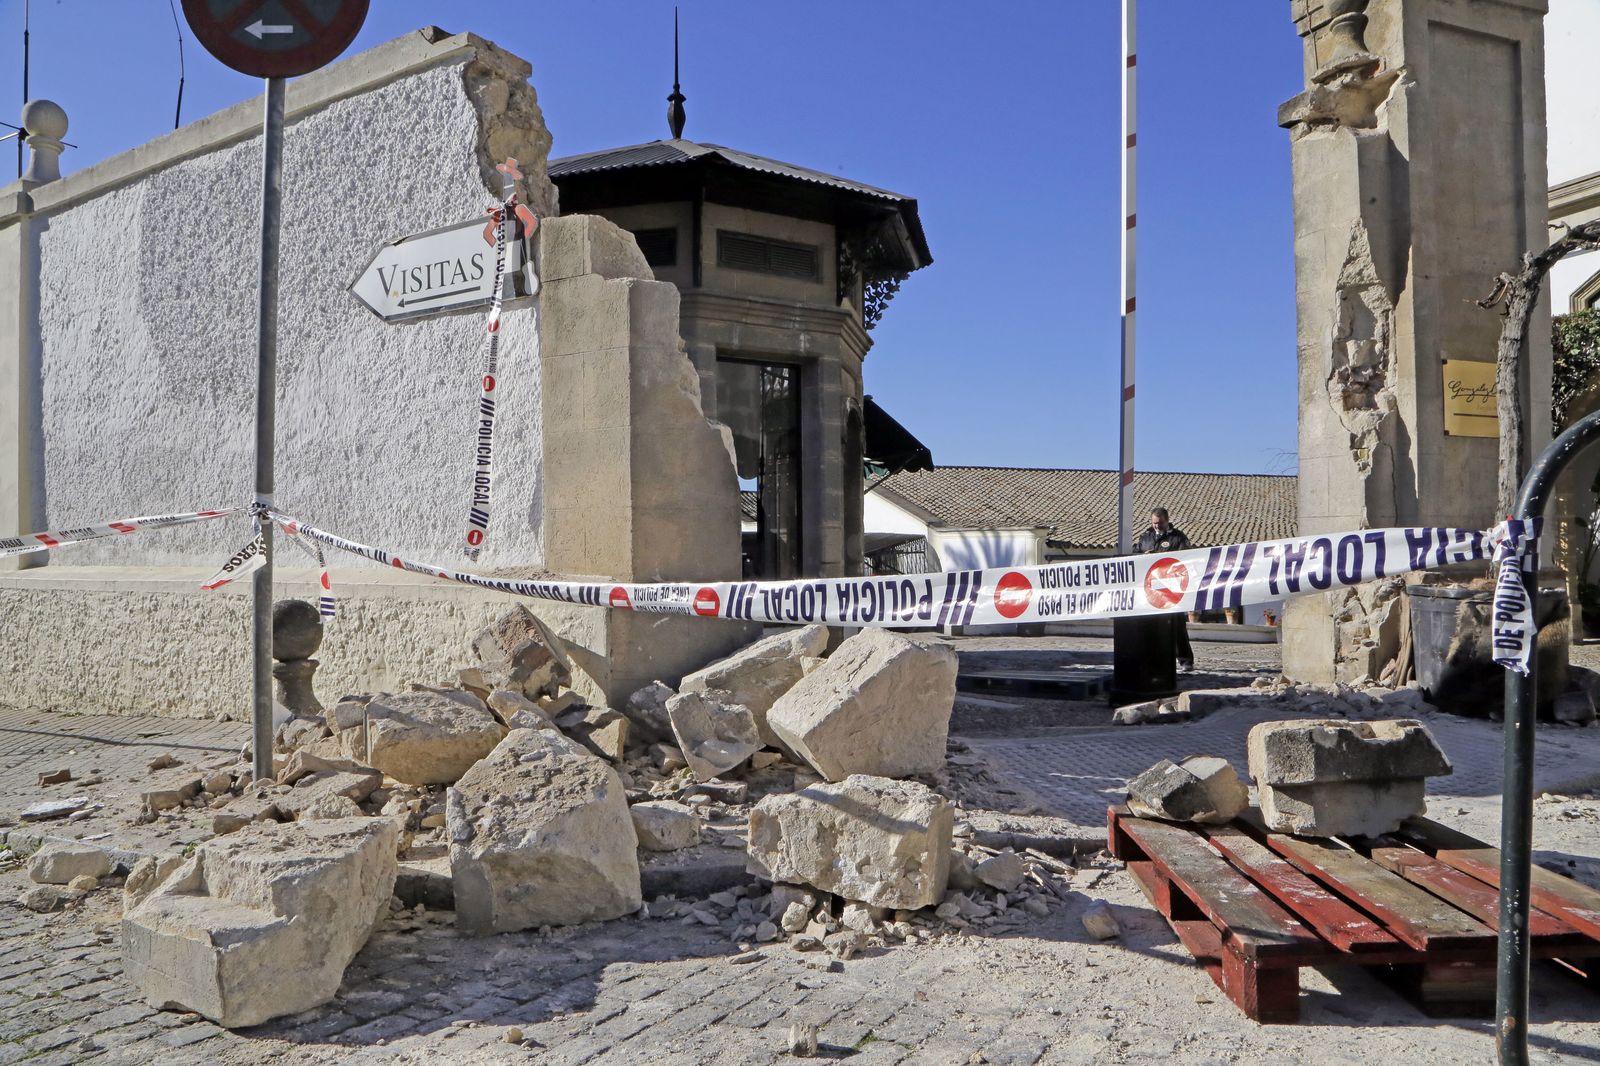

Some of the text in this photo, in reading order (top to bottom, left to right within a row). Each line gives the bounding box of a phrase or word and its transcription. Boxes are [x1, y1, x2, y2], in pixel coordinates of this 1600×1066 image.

[376, 253, 484, 298] VISITAS
[474, 419, 493, 506] POLICIA LOCAL
[1038, 560, 1136, 589] LINEA DE POLICIA
[1264, 532, 1386, 595] LOCAL
[759, 578, 933, 622] POLICIA LOCAL
[1038, 590, 1135, 616] PROIDO EL PASO
[1493, 628, 1524, 651] DE
